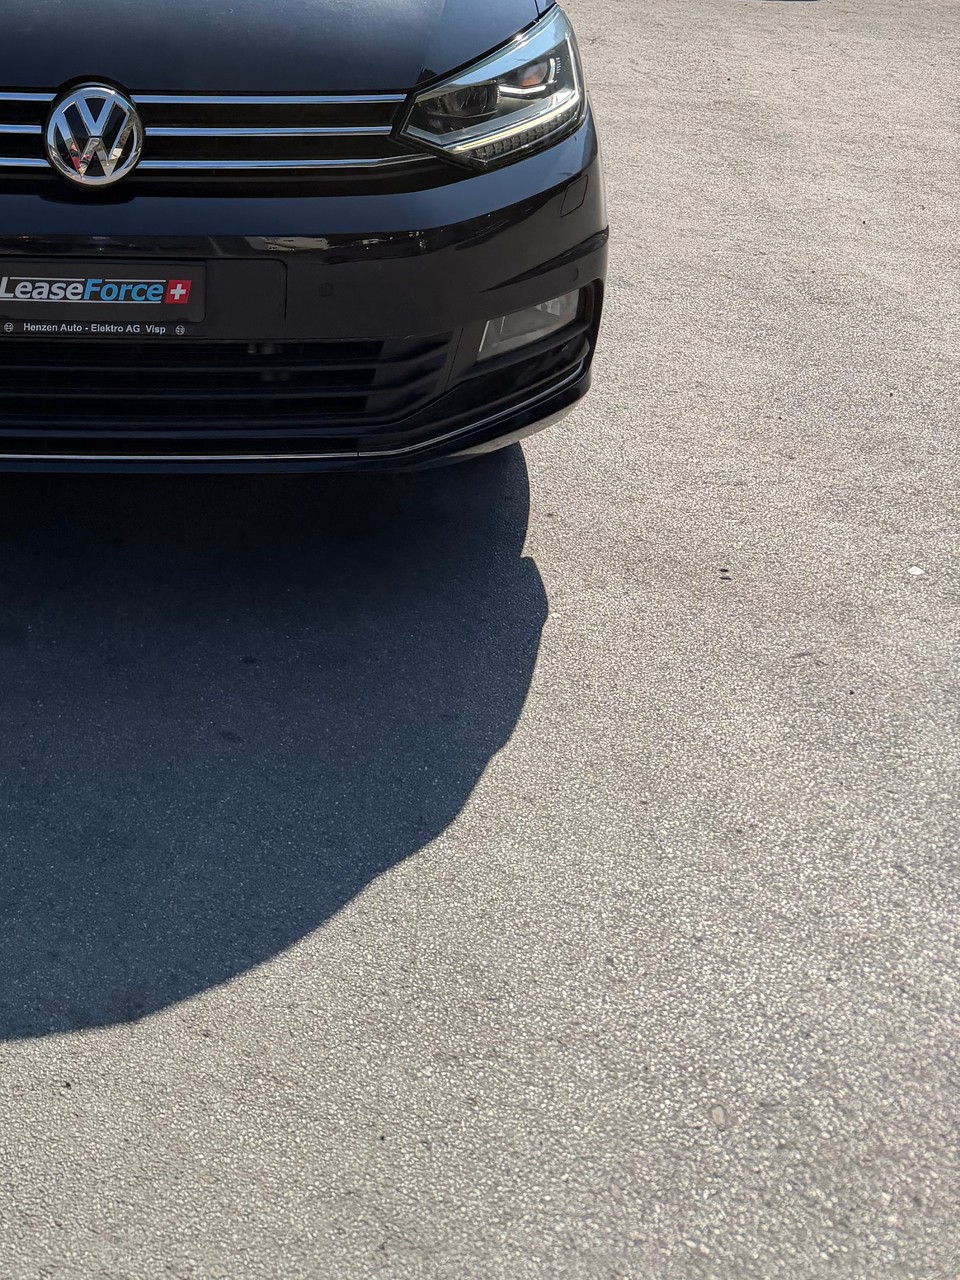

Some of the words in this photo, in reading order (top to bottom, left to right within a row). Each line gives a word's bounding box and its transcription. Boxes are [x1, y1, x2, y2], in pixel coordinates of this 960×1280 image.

[23, 322, 58, 332] Henzen
[60, 323, 83, 332] Auto
[91, 323, 124, 333] Elektro
[126, 324, 141, 333] AG
[146, 324, 166, 335] Visp
